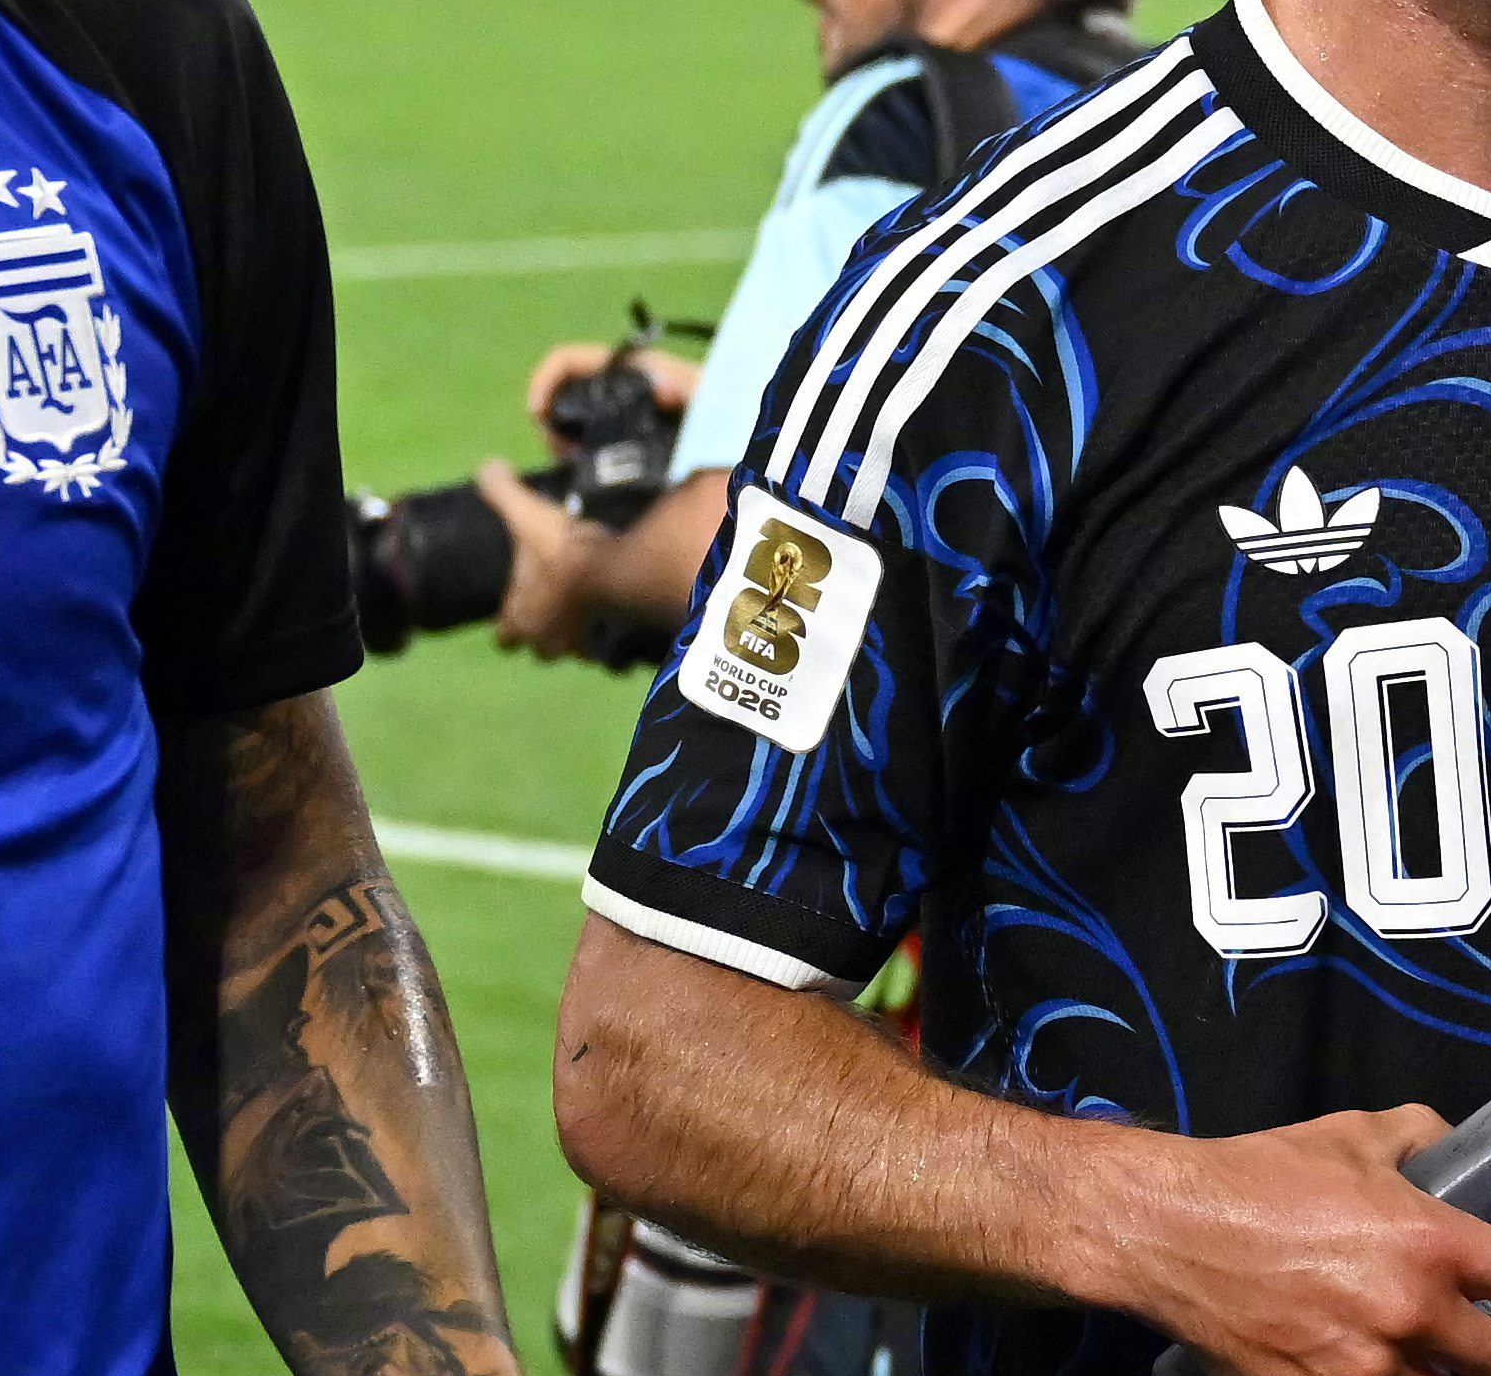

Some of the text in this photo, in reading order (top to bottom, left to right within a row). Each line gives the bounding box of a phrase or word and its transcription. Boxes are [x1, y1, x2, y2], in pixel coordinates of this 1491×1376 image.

[0, 305, 93, 414] AFA
[739, 630, 775, 661] FIFA
[704, 670, 782, 721] 2026
[713, 653, 788, 698] WORLD CUP
